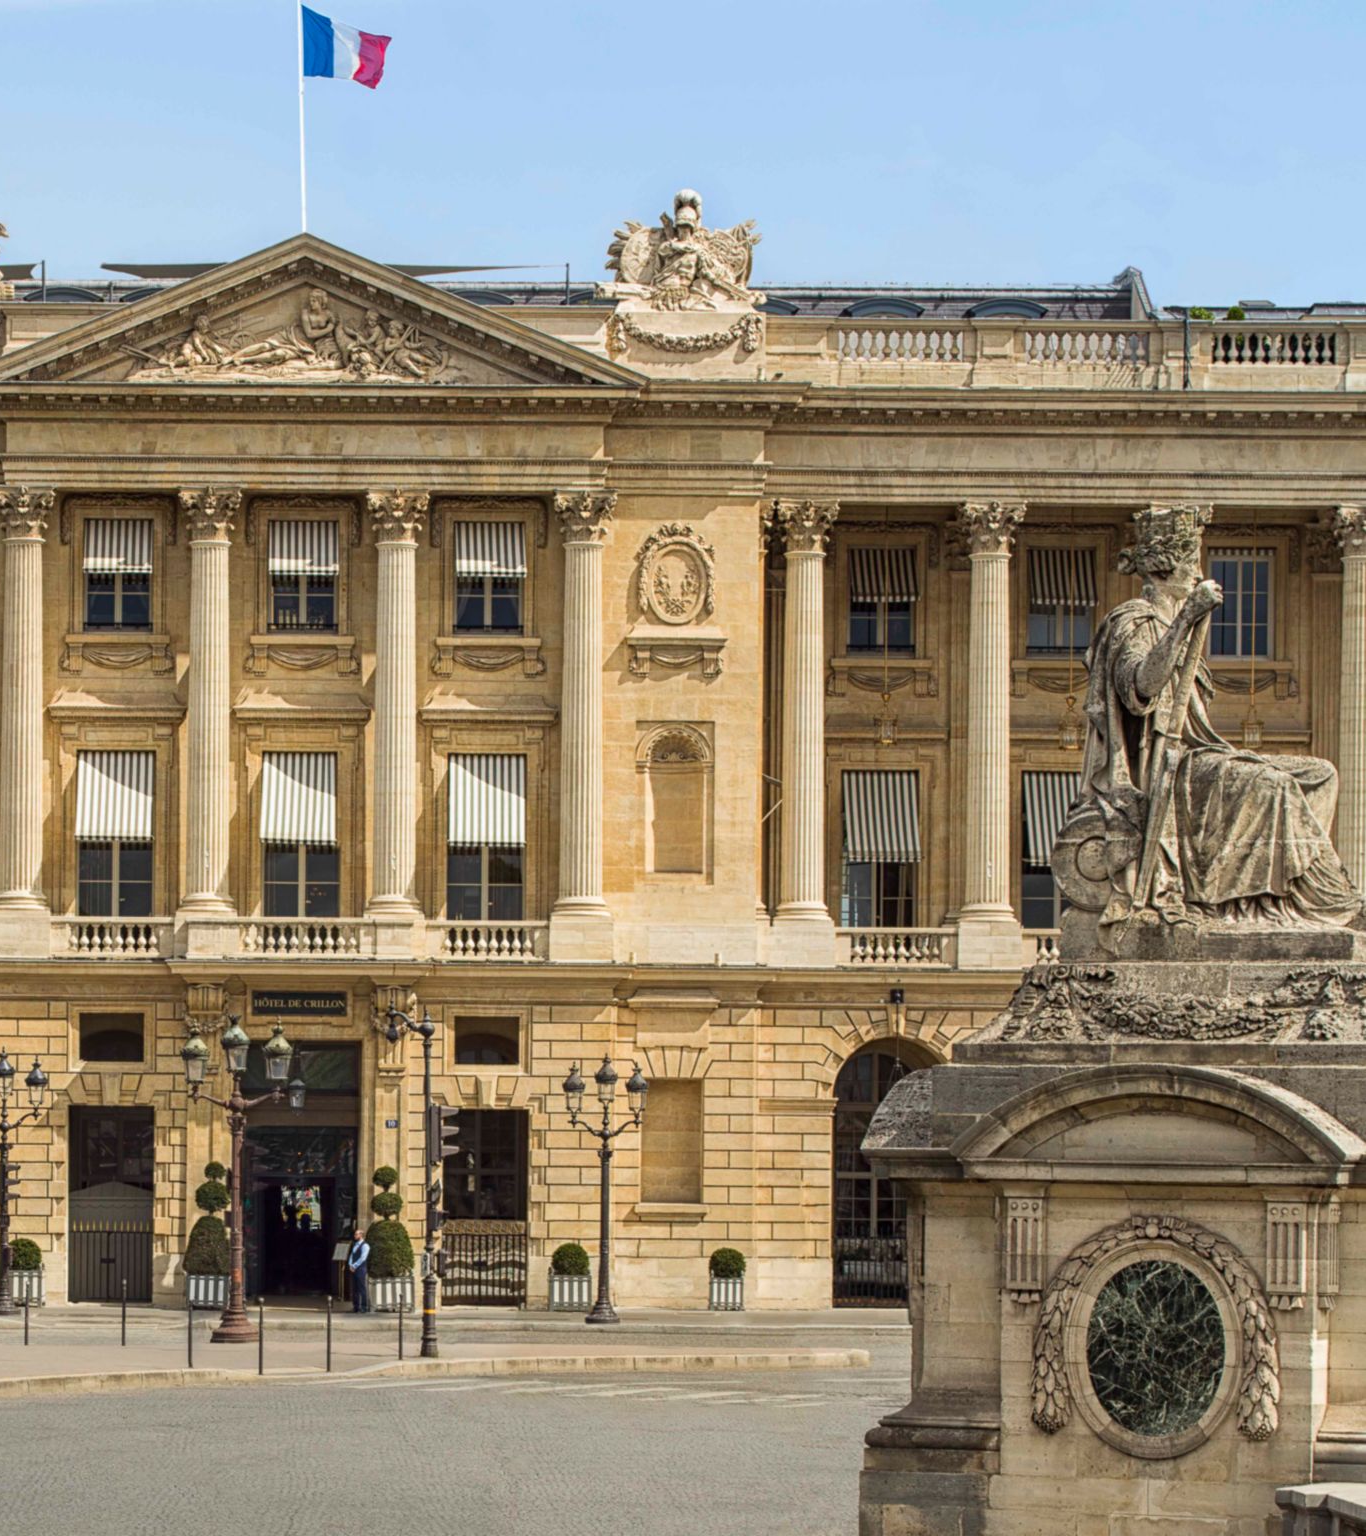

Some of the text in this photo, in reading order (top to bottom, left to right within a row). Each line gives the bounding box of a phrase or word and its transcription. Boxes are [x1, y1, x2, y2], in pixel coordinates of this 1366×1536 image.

[254, 997, 345, 1009] HÔTEL DE CRILLON
